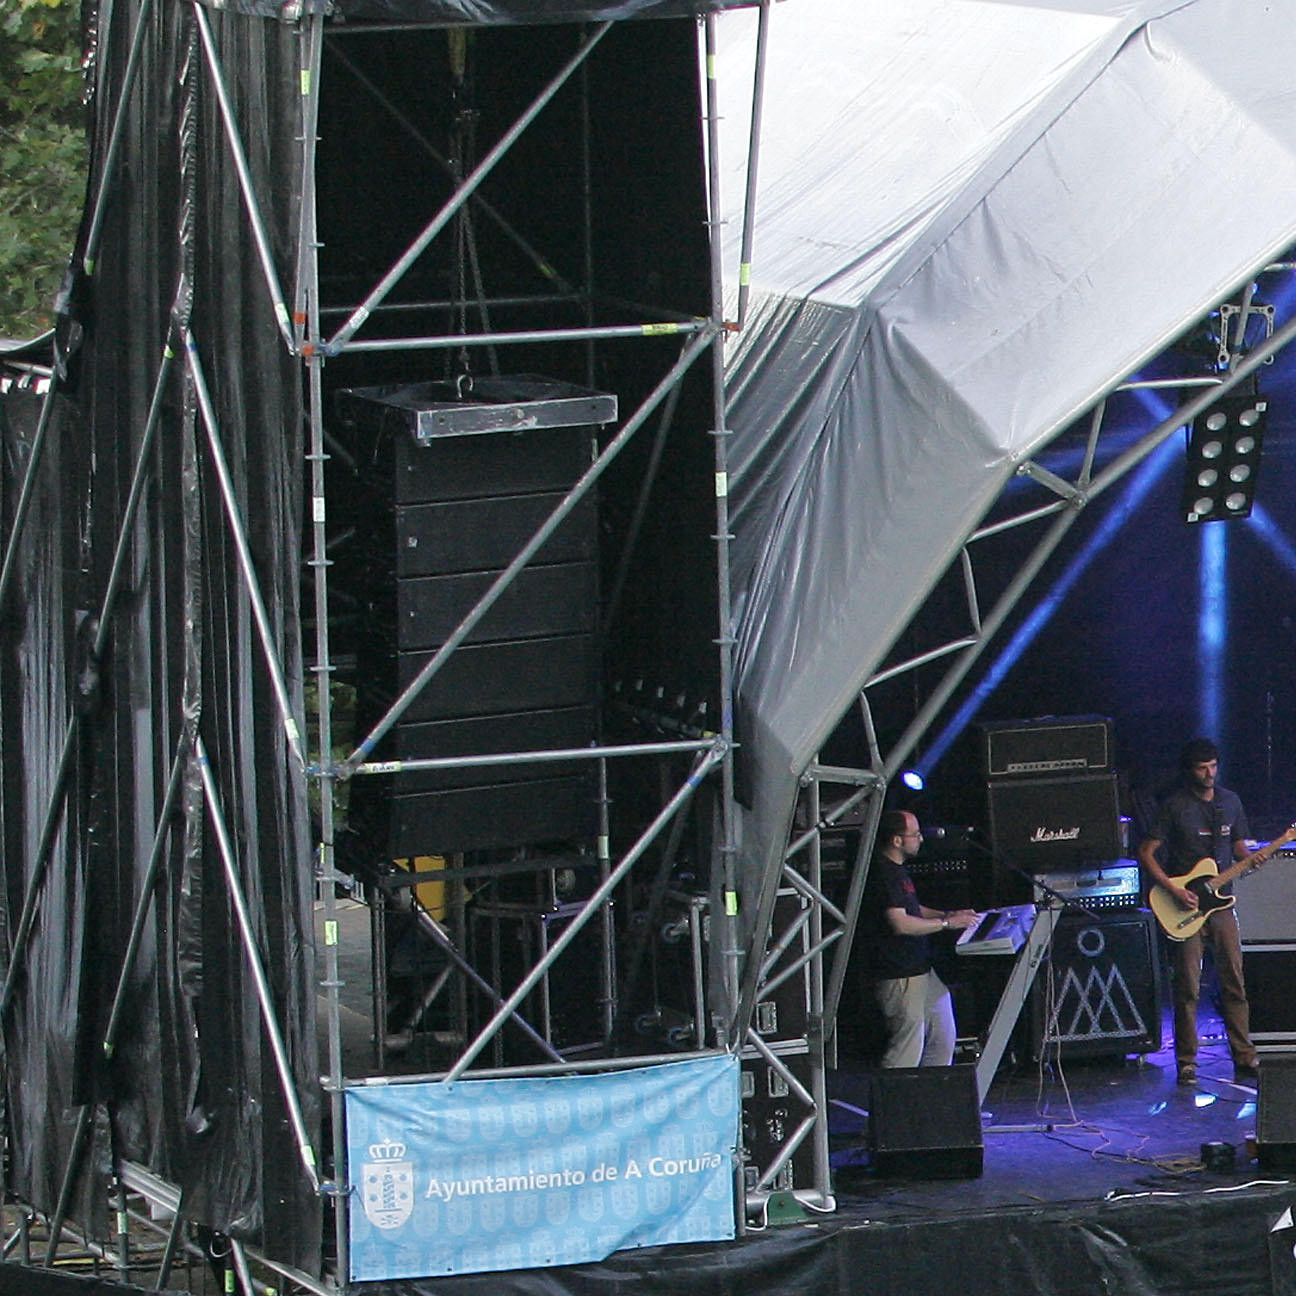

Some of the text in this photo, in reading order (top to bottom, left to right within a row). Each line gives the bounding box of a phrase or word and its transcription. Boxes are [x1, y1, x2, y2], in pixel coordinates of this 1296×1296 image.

[1030, 827, 1080, 842] Marshall
[424, 1152, 722, 1202] Ayuntamiento de A Coruña
